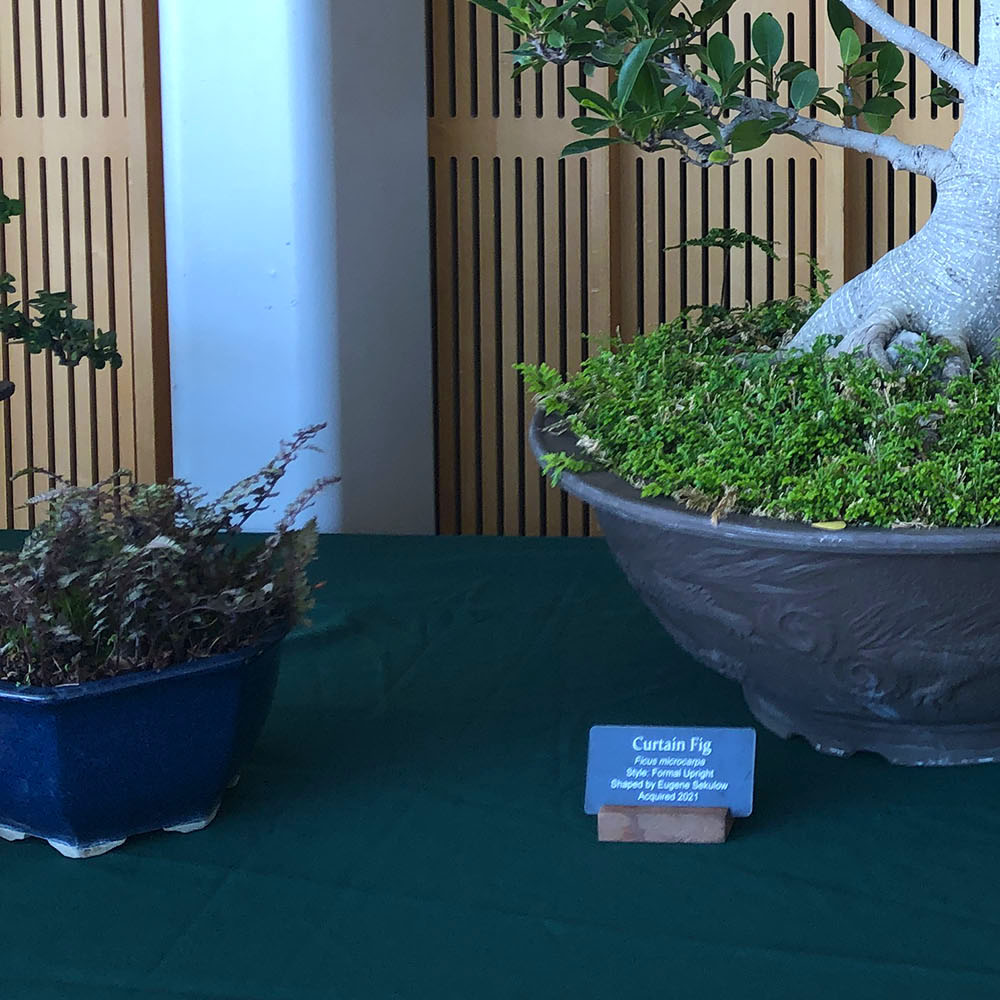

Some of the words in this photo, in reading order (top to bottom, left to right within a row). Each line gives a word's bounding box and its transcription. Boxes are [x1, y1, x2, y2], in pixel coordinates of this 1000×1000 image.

[632, 735, 686, 752] Curtain
[689, 736, 713, 755] Fig
[634, 755, 657, 766] Ficus
[658, 756, 706, 767] microcarpa
[626, 768, 650, 779] Style:
[651, 768, 681, 778] Formal
[683, 768, 714, 780] Upright
[610, 778, 643, 791] Shaped
[645, 779, 656, 791] by
[657, 780, 690, 791] Eugene
[637, 791, 676, 803] Acquired
[677, 792, 699, 802] 2021
